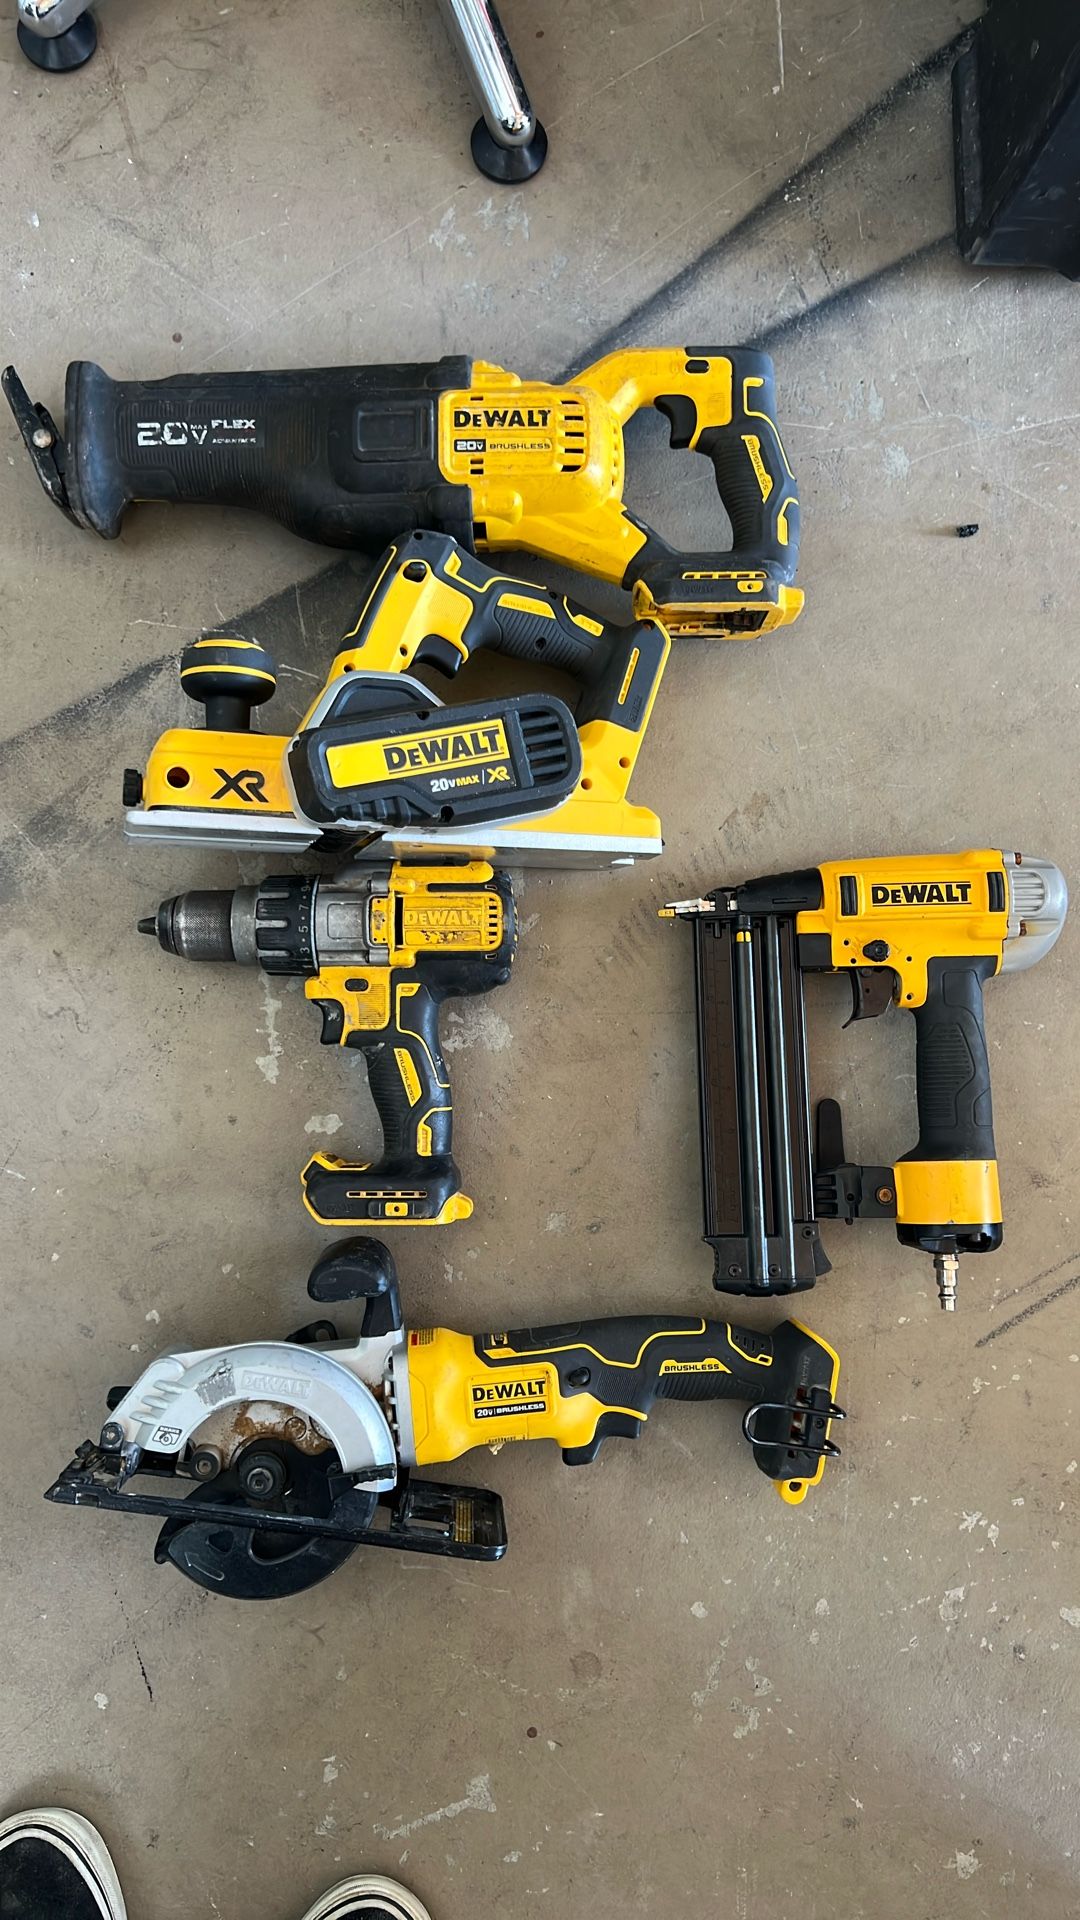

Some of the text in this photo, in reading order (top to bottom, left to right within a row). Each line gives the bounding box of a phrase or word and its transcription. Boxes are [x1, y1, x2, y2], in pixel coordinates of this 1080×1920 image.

[211, 419, 256, 429] FLEX
[454, 409, 551, 428] DEWALT
[456, 441, 484, 451] 20V
[747, 438, 768, 491] BRUSHLESS
[384, 729, 500, 771] DEWALT
[486, 766, 511, 784] XR
[210, 768, 269, 803] XR
[871, 884, 972, 905] DEWALT
[397, 1050, 416, 1102] BRUSHLESS
[664, 1363, 720, 1372] BRUSHLESS
[472, 1380, 546, 1402] DEWALT
[496, 1402, 545, 1414] BRUSHLESS
